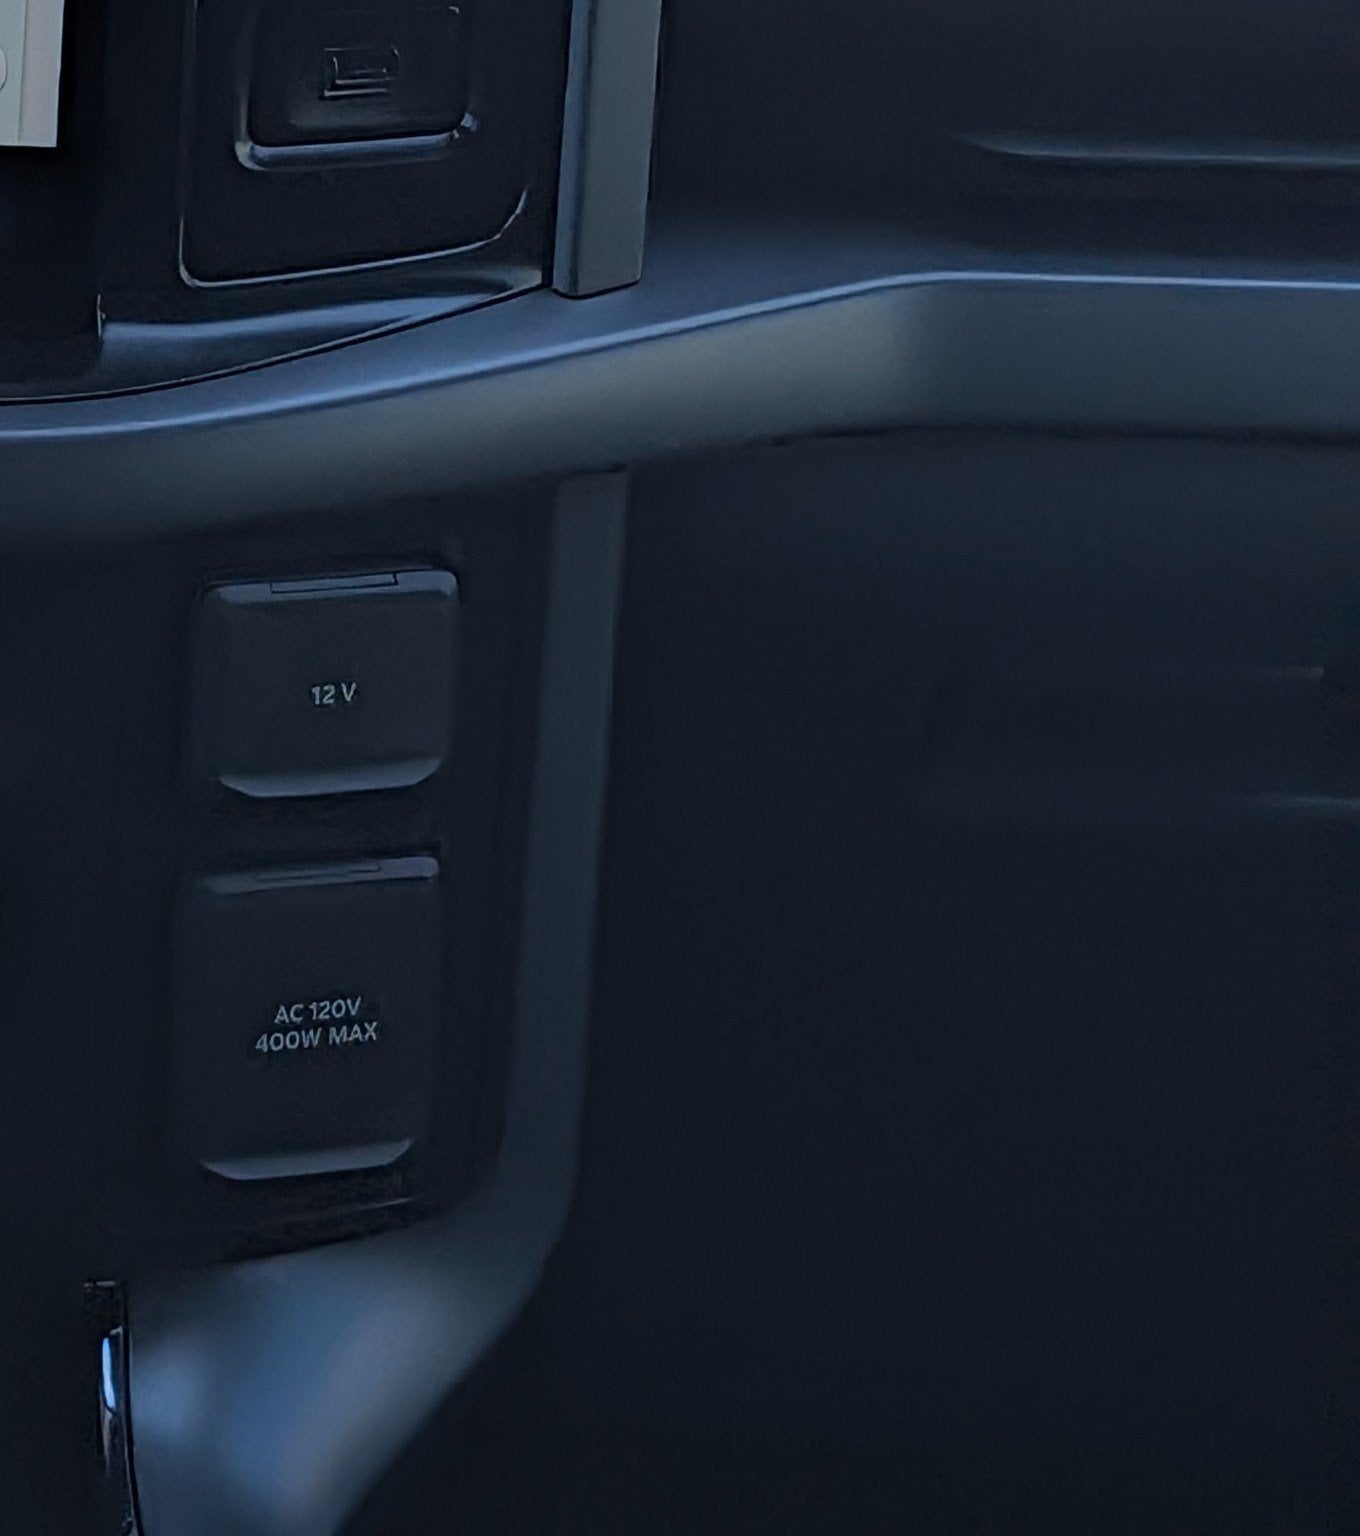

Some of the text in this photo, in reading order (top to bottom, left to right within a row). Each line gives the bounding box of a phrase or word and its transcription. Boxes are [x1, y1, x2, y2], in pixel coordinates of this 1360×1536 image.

[310, 681, 359, 706] 12 V
[273, 995, 363, 1025] AC 120V
[255, 1019, 379, 1054] 400W MAX
